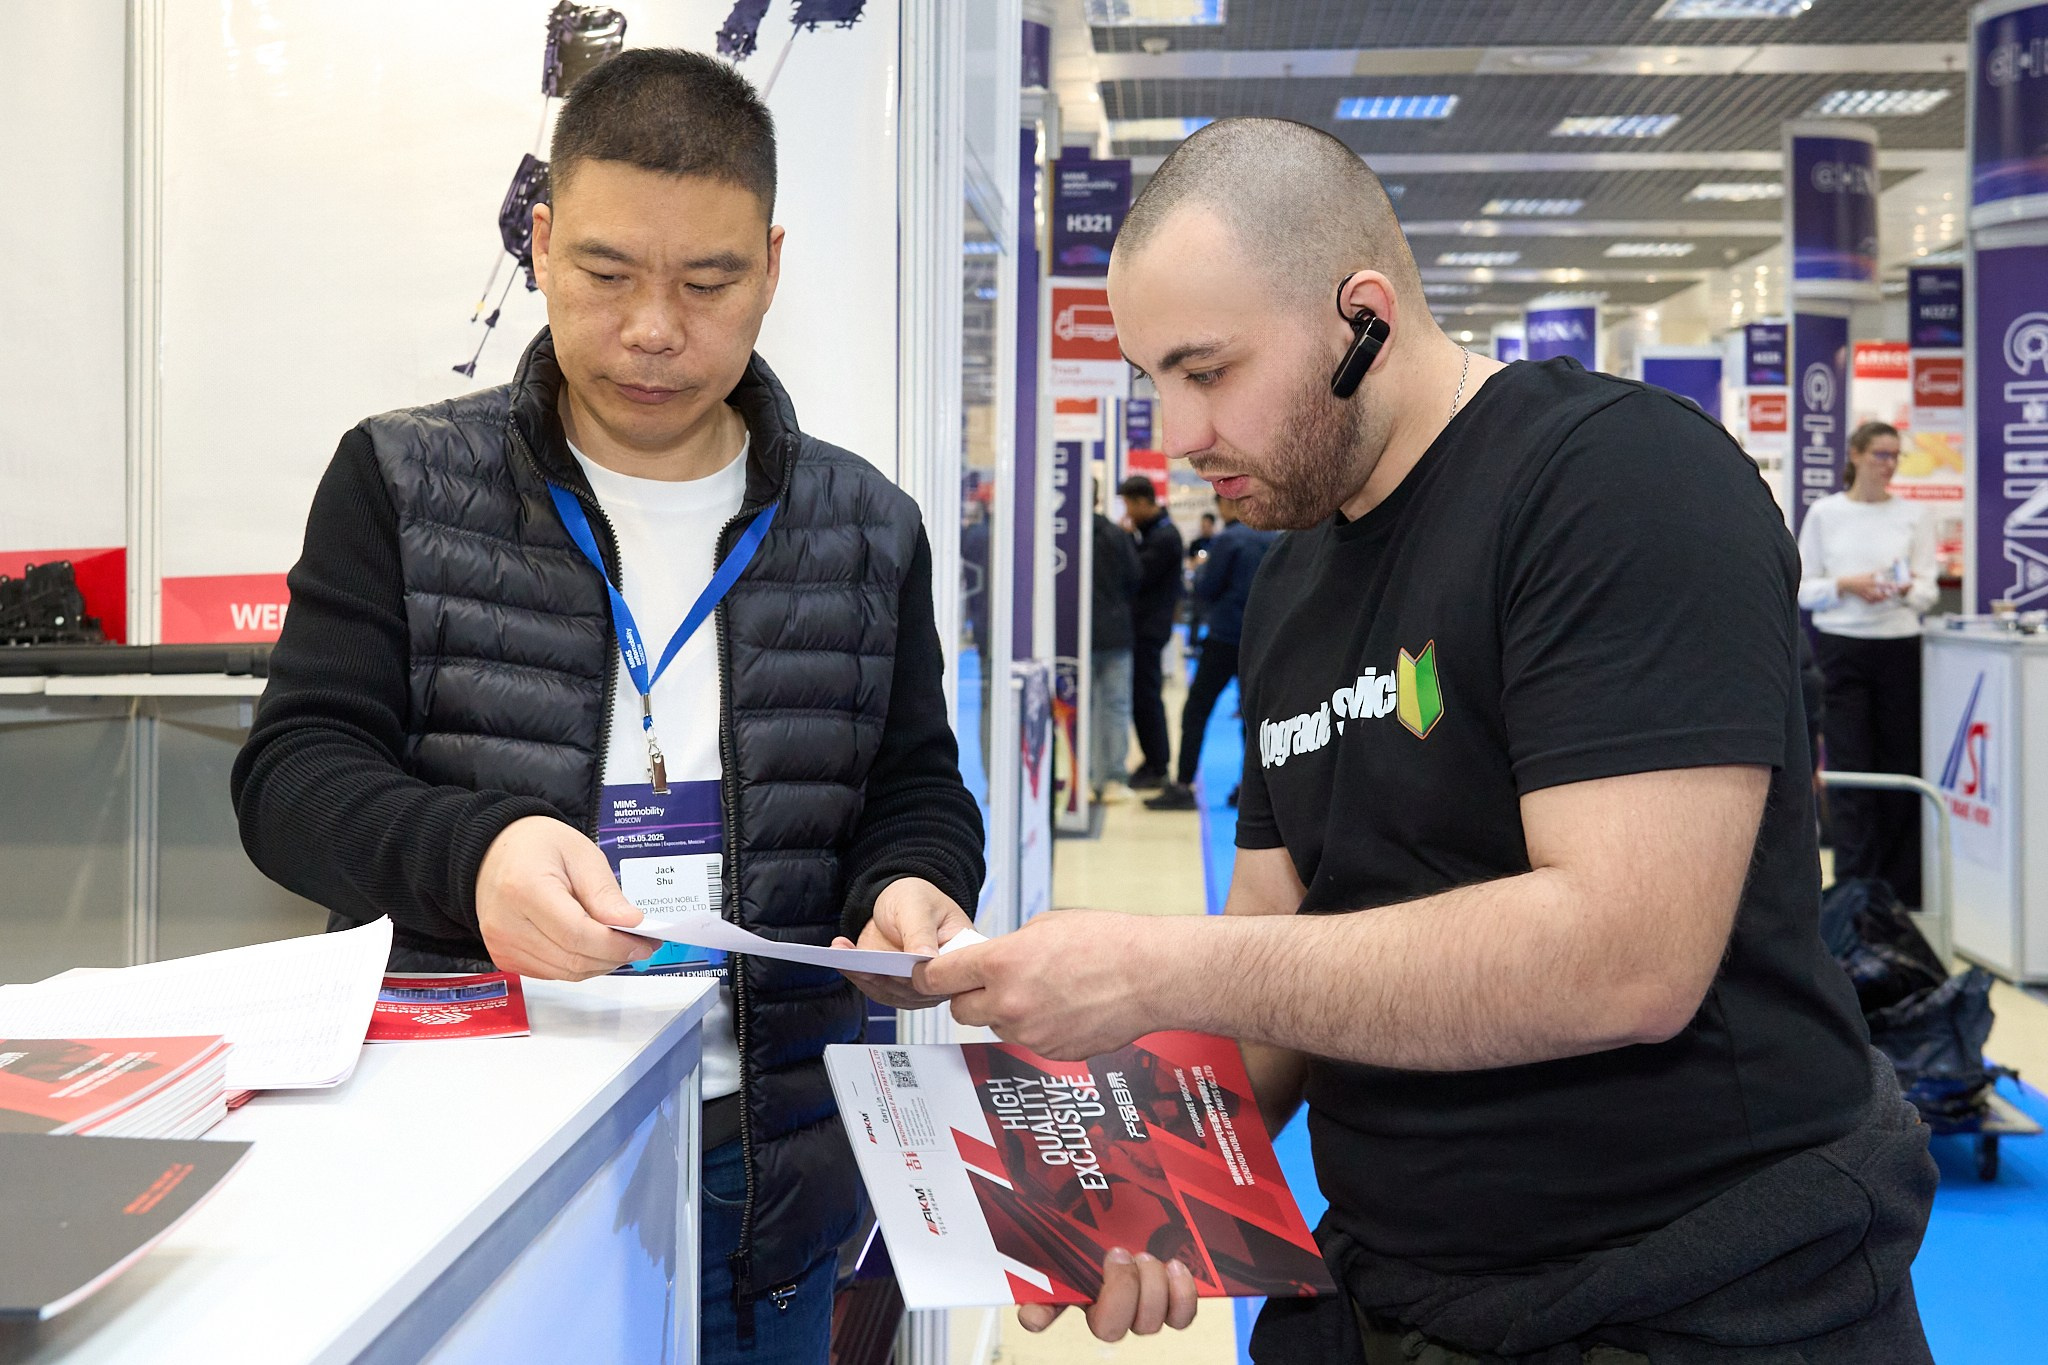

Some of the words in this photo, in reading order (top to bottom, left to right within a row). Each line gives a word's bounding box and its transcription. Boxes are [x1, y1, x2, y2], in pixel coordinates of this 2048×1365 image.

[1066, 214, 1112, 233] H321
[626, 628, 641, 666] automobility
[625, 650, 636, 669] MIMS
[613, 799, 637, 809] MIMS
[614, 806, 665, 817] automobility
[655, 866, 675, 875] Jack
[656, 877, 673, 886] Shu
[635, 897, 673, 906] WENZHOU
[675, 895, 699, 904] NOBLE
[649, 906, 674, 914] PARTS
[687, 968, 729, 978] EXHIBITOR
[879, 1070, 888, 1086] PARTS
[1174, 1068, 1192, 1101] BROCHURE
[876, 1096, 885, 1107] Lin
[884, 1087, 893, 1101] AUTO
[1067, 1074, 1106, 1117] USE
[1212, 1090, 1227, 1112] PARTS
[890, 1102, 900, 1119] NOBLE
[986, 1078, 1028, 1130] HIGH
[1107, 1071, 1147, 1139] 产品目录
[880, 1107, 889, 1124] Gary
[1012, 1076, 1070, 1165] QUALITY
[1186, 1102, 1205, 1138] CORPORATE
[1220, 1112, 1233, 1129] AUTO
[894, 1119, 909, 1146] WENZHOU
[1040, 1075, 1109, 1190] EXCLUSIVE
[1226, 1130, 1242, 1152] NOBLE
[1236, 1153, 1255, 1186] WENZHOU
[915, 1187, 938, 1229] AKM
